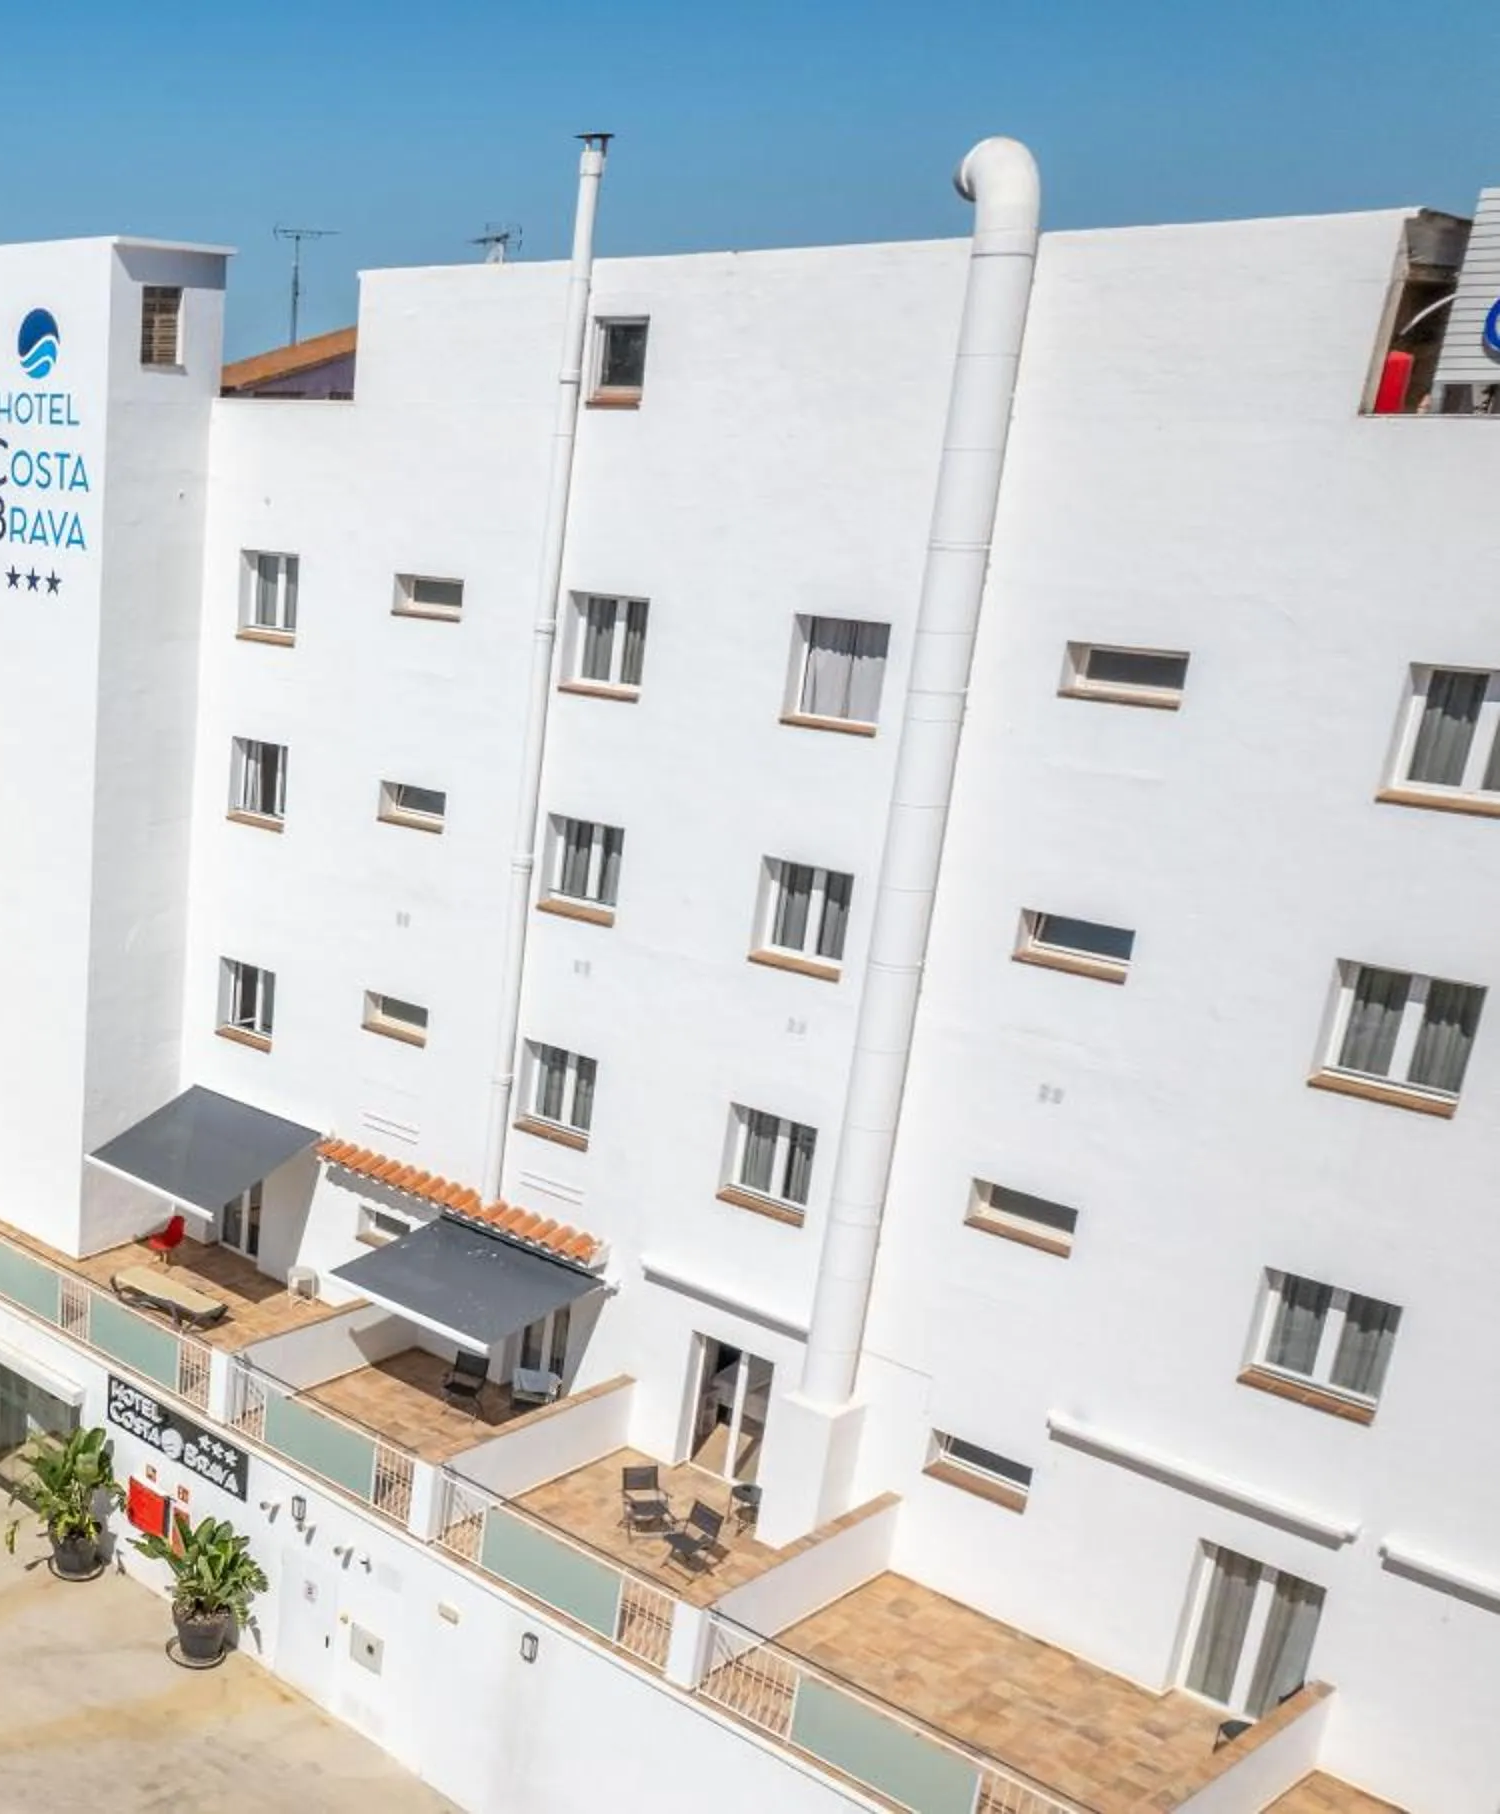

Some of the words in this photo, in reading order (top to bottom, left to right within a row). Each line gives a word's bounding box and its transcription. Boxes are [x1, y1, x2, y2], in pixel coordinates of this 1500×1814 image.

[110, 1380, 163, 1423] HOTEL
[110, 1400, 162, 1447] COSTA
[183, 1443, 239, 1493] BRAVA
